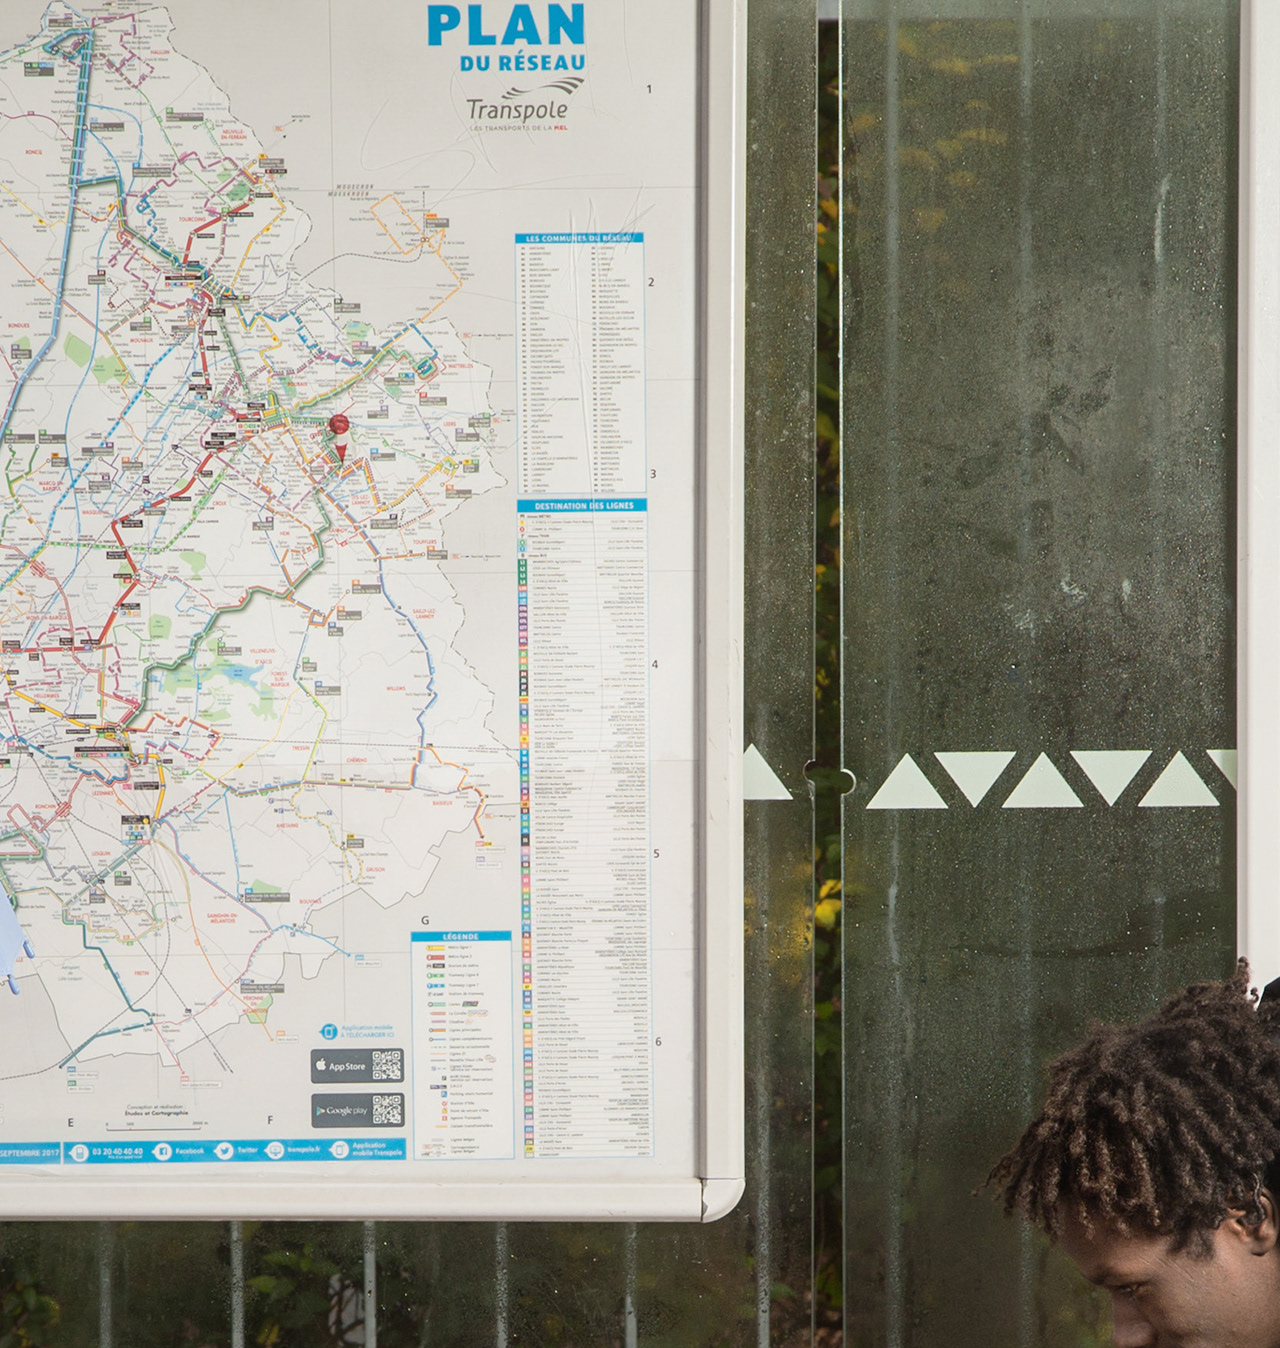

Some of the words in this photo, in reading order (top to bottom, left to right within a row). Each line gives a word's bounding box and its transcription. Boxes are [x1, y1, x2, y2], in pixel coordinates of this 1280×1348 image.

[428, 4, 584, 46] PLAN
[460, 55, 490, 71] DU
[499, 50, 585, 71] RÉSEAU
[647, 85, 651, 93] 1
[467, 99, 567, 123] Transpole
[649, 278, 654, 287] 2
[650, 469, 656, 478] 3
[590, 502, 603, 510] DES
[652, 660, 658, 668] 4
[654, 849, 660, 858] 5
[421, 916, 429, 925] G
[655, 1037, 661, 1046] 6
[329, 1063, 344, 1072] App
[327, 1106, 352, 1116] Google
[353, 1107, 367, 1115] play
[68, 1118, 74, 1127] E
[268, 1115, 273, 1124] F
